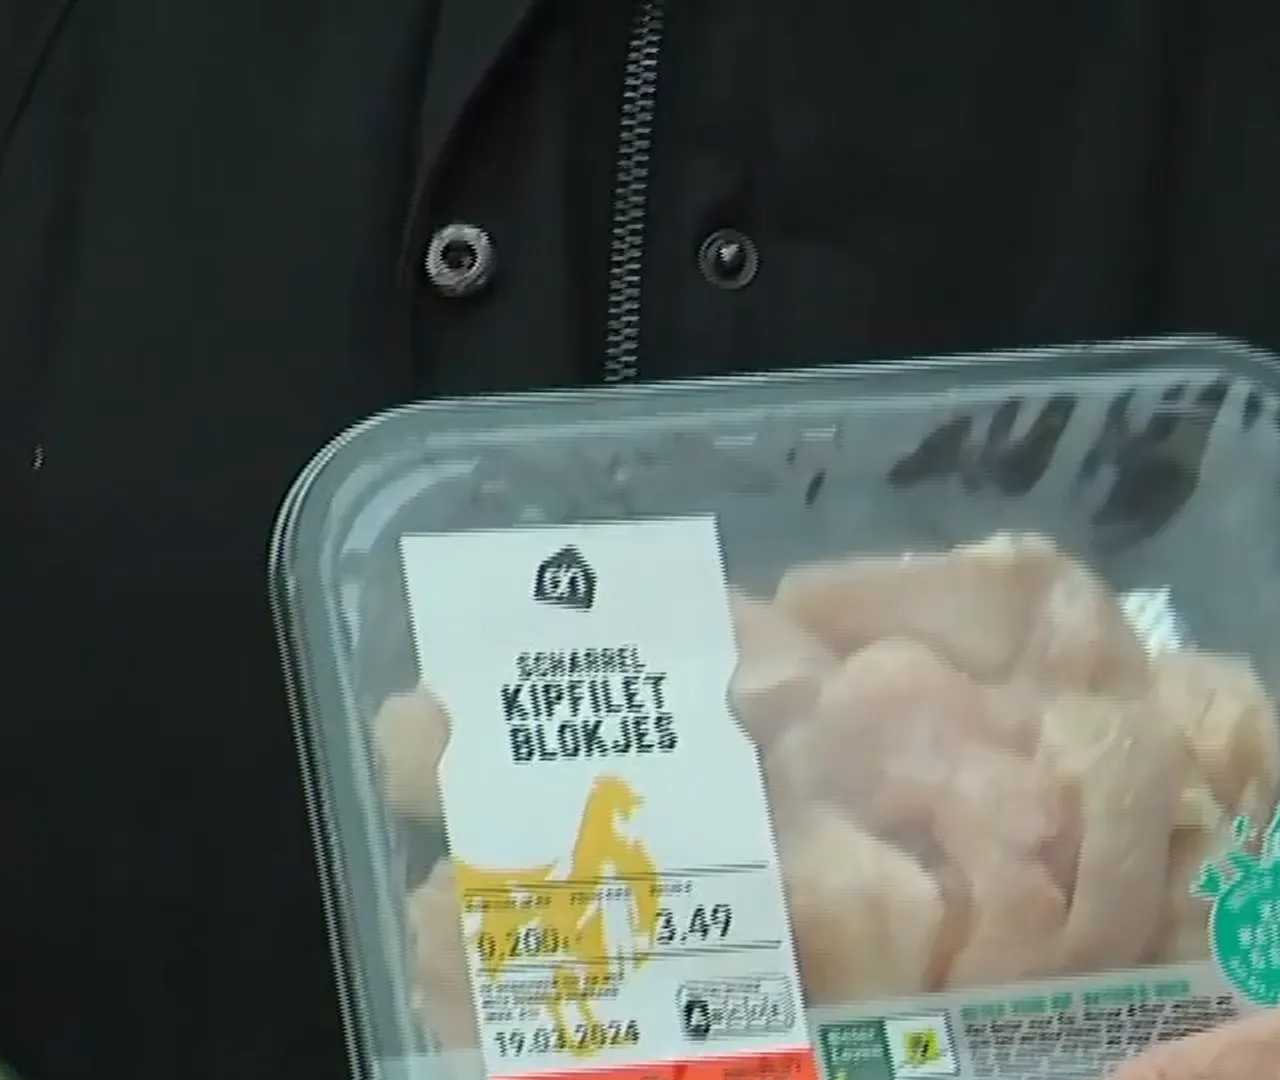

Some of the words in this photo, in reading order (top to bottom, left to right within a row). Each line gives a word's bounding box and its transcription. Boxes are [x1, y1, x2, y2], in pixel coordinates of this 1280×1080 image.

[517, 645, 646, 680] SCHARREL
[501, 671, 667, 721] KIPFILET
[510, 711, 677, 763] BLOKJES
[655, 902, 732, 944] 3.49
[494, 1019, 640, 1057] 19.03.2024
[831, 1043, 886, 1065] Leven
